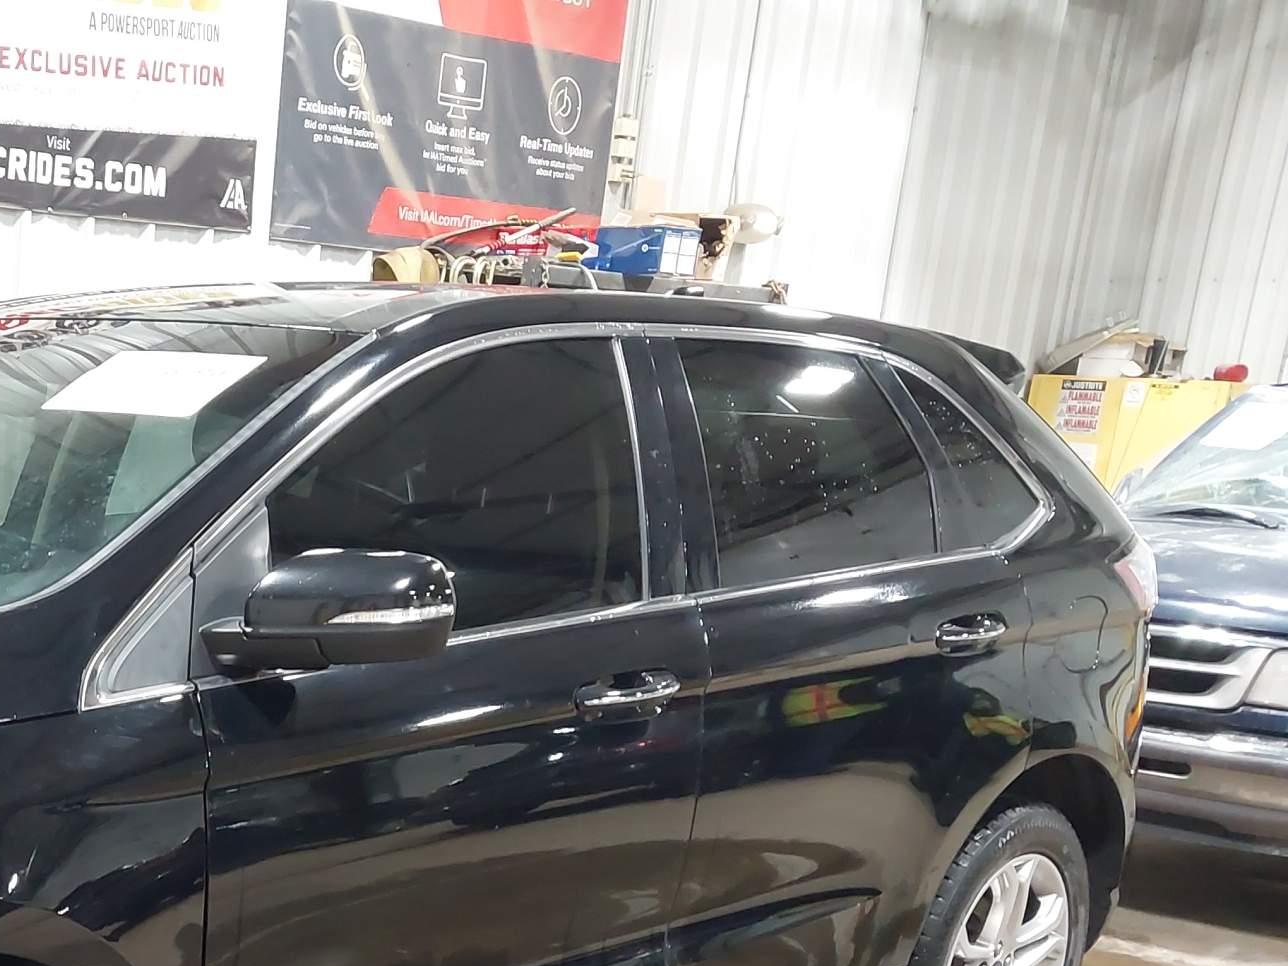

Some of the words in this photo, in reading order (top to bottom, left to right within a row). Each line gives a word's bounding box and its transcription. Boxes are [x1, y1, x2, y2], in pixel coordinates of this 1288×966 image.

[89, 11, 97, 31] A
[101, 12, 175, 38] POWERSPORT
[177, 20, 220, 42] AUCTION
[136, 59, 225, 87] AUCTION
[298, 97, 347, 118] Exclusive
[348, 104, 371, 121] First
[304, 118, 317, 129] Bid
[318, 122, 327, 130] on
[328, 123, 352, 135] vehicles
[353, 127, 374, 138] before
[425, 119, 448, 137] Quick
[449, 126, 466, 139] and
[469, 127, 490, 144] Easy
[46, 135, 71, 151] Visit
[313, 133, 323, 142] go
[324, 133, 331, 142] to
[332, 134, 343, 144] the
[344, 136, 354, 146] live
[355, 139, 378, 150] auction
[520, 135, 563, 154] Real-Time
[564, 142, 594, 159] Updates
[447, 163, 456, 173] for
[399, 206, 418, 222] Visit
[1068, 391, 1102, 403] FLAMMABLE
